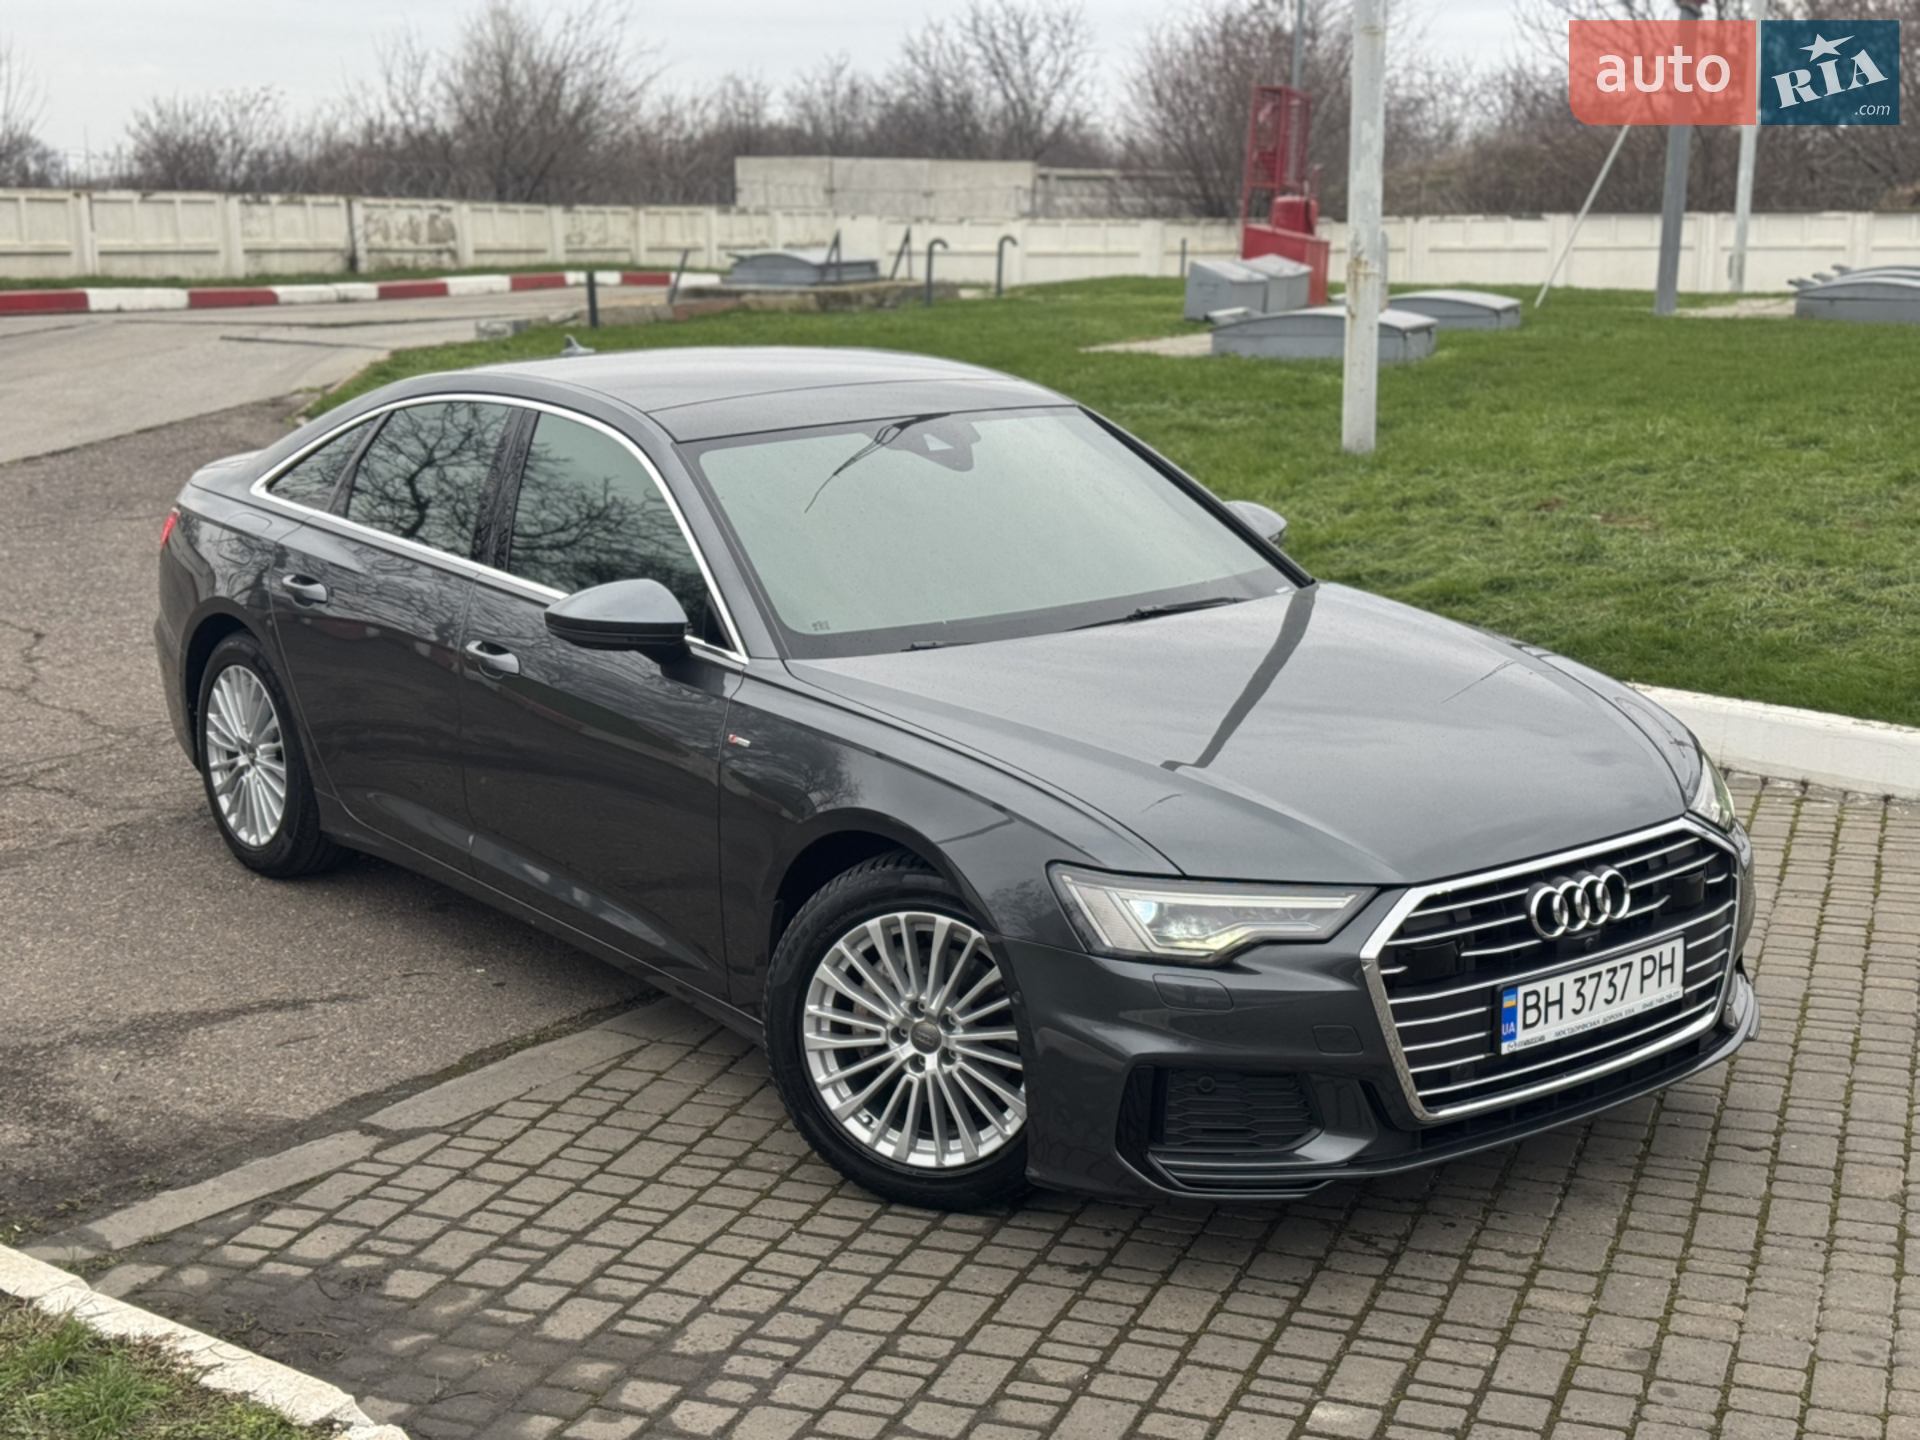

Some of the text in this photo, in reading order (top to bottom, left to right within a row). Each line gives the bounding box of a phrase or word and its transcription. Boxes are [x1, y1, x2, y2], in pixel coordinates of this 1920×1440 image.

[1522, 946, 1676, 1031] BH 3737 PH
[1502, 1022, 1516, 1036] UA
